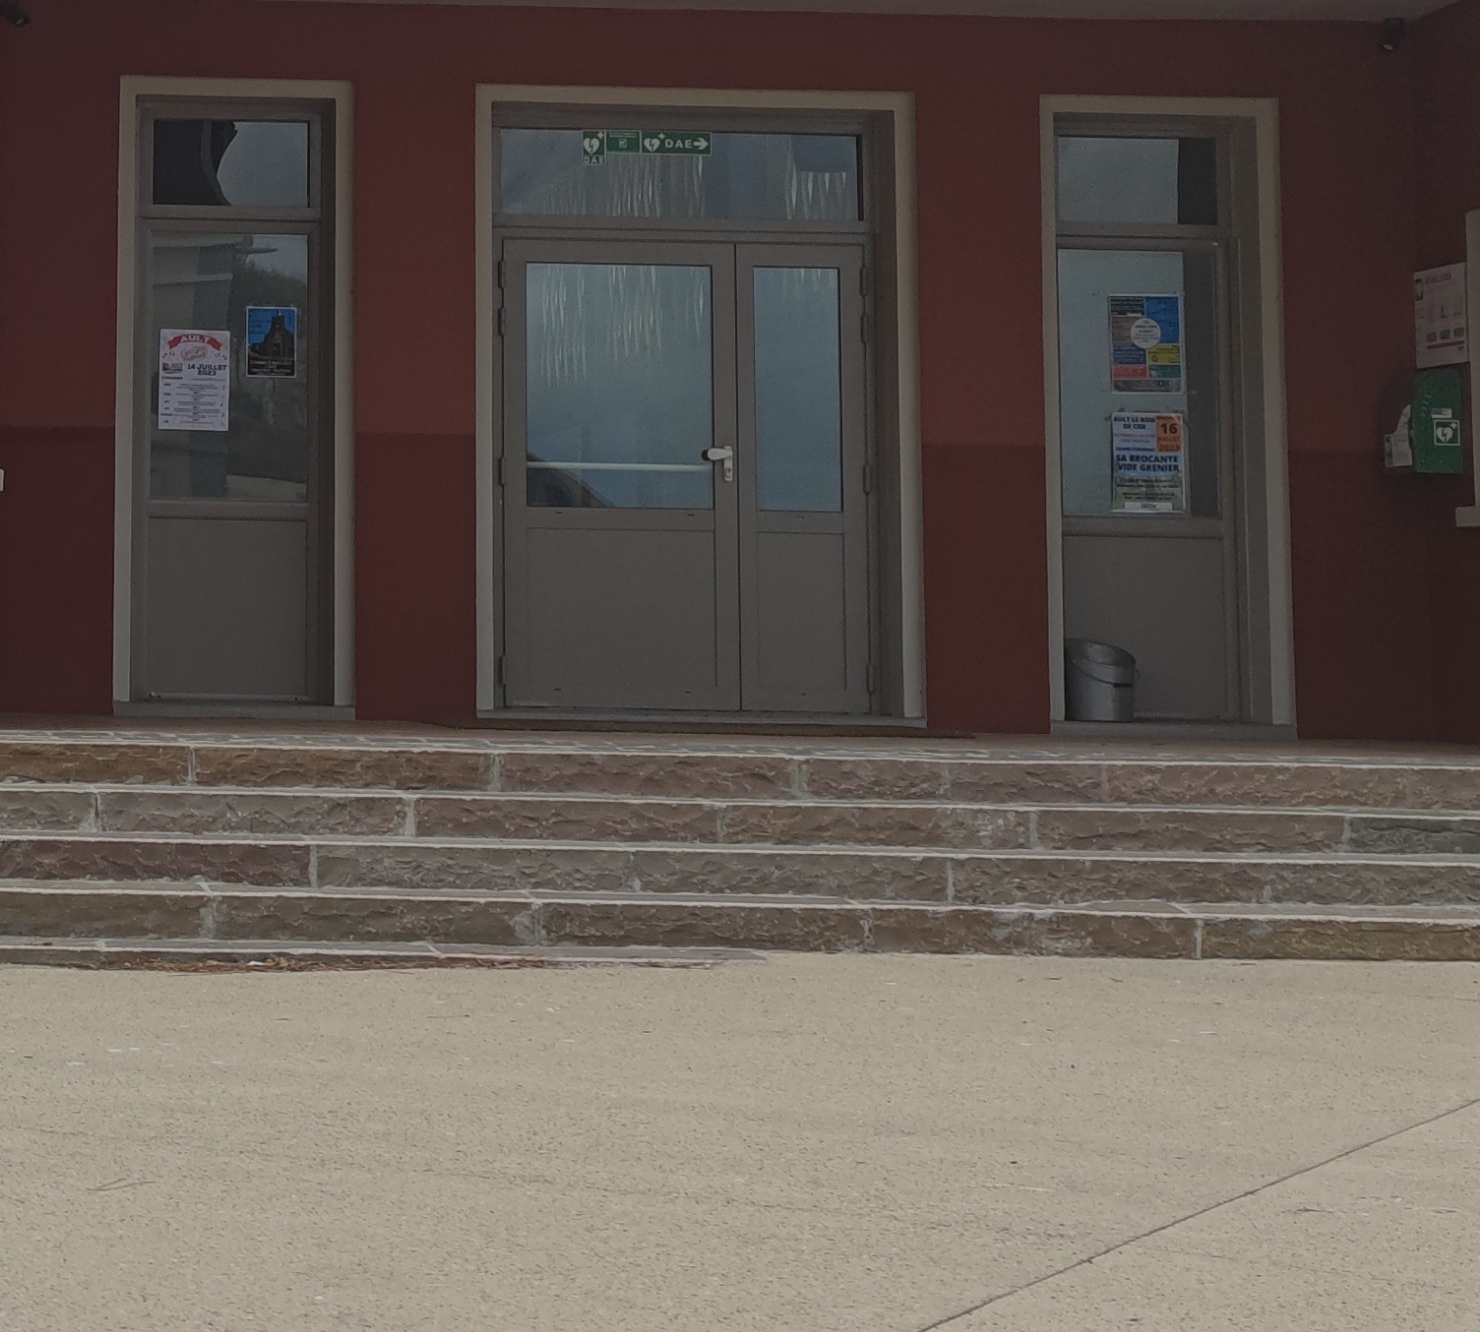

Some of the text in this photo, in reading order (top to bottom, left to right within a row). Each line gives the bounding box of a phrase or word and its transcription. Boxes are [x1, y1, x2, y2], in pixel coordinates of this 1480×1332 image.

[665, 139, 693, 149] DAE
[583, 155, 604, 164] DAE
[179, 334, 211, 344] AULT
[1161, 423, 1178, 434] 16
[1129, 455, 1179, 463] BROCANTE
[1117, 463, 1179, 472] VIDE GRENIER
